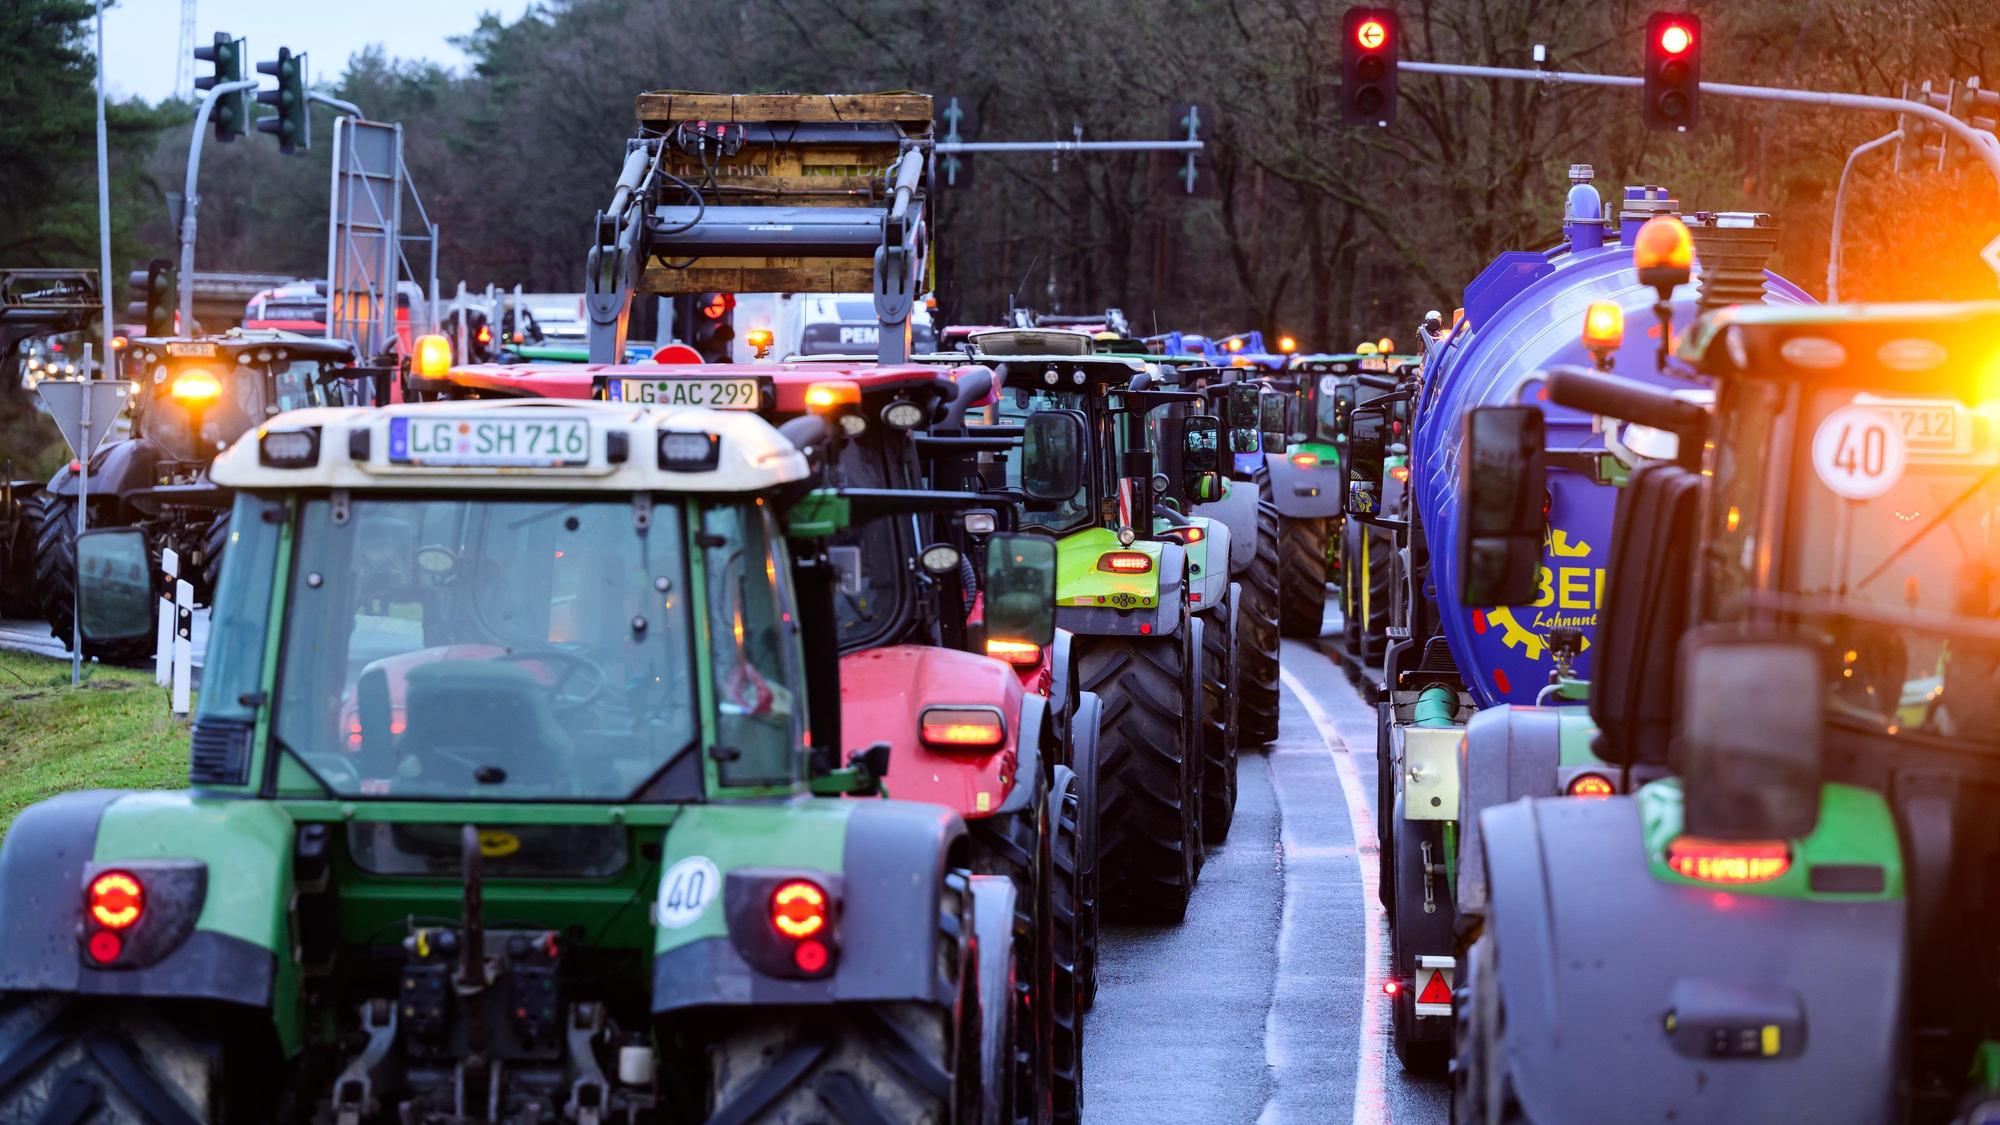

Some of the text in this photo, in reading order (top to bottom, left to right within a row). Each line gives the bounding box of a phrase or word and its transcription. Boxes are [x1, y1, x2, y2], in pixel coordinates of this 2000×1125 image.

[840, 326, 880, 345] PEM
[624, 382, 754, 405] LG AC 299
[1901, 411, 1950, 438] 712
[411, 423, 583, 454] LG SH 716
[1832, 422, 1887, 478] 40
[1532, 610, 1599, 629] Lohnunt
[667, 868, 705, 912] 40
